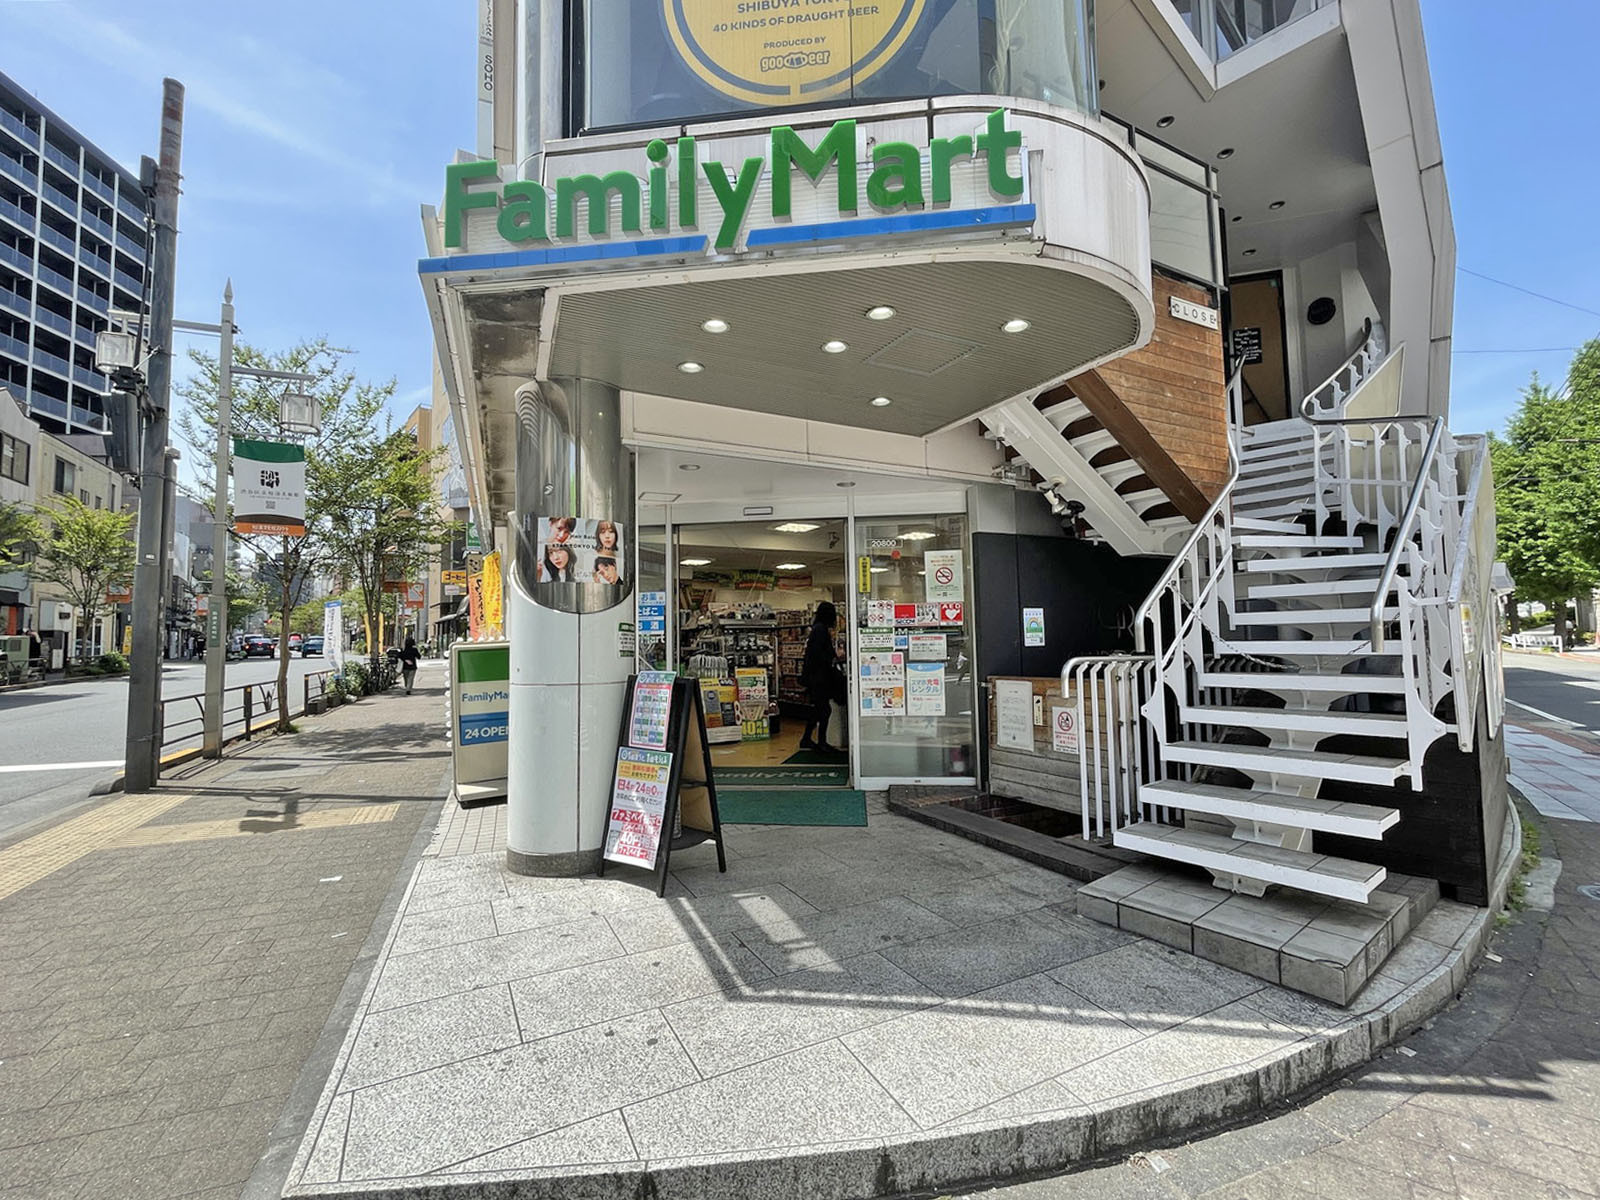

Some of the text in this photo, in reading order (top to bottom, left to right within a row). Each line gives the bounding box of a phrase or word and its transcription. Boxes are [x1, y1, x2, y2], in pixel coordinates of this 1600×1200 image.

[713, 5, 879, 33] 40 KINDS OF DRAUGHT BEER
[763, 36, 826, 49] PRODUCED BY
[484, 54, 494, 92] SOHO
[445, 108, 1024, 250] FamilyMart
[1173, 303, 1217, 325] CLOSE
[465, 728, 479, 740] 24
[712, 771, 839, 779] amilyMart
